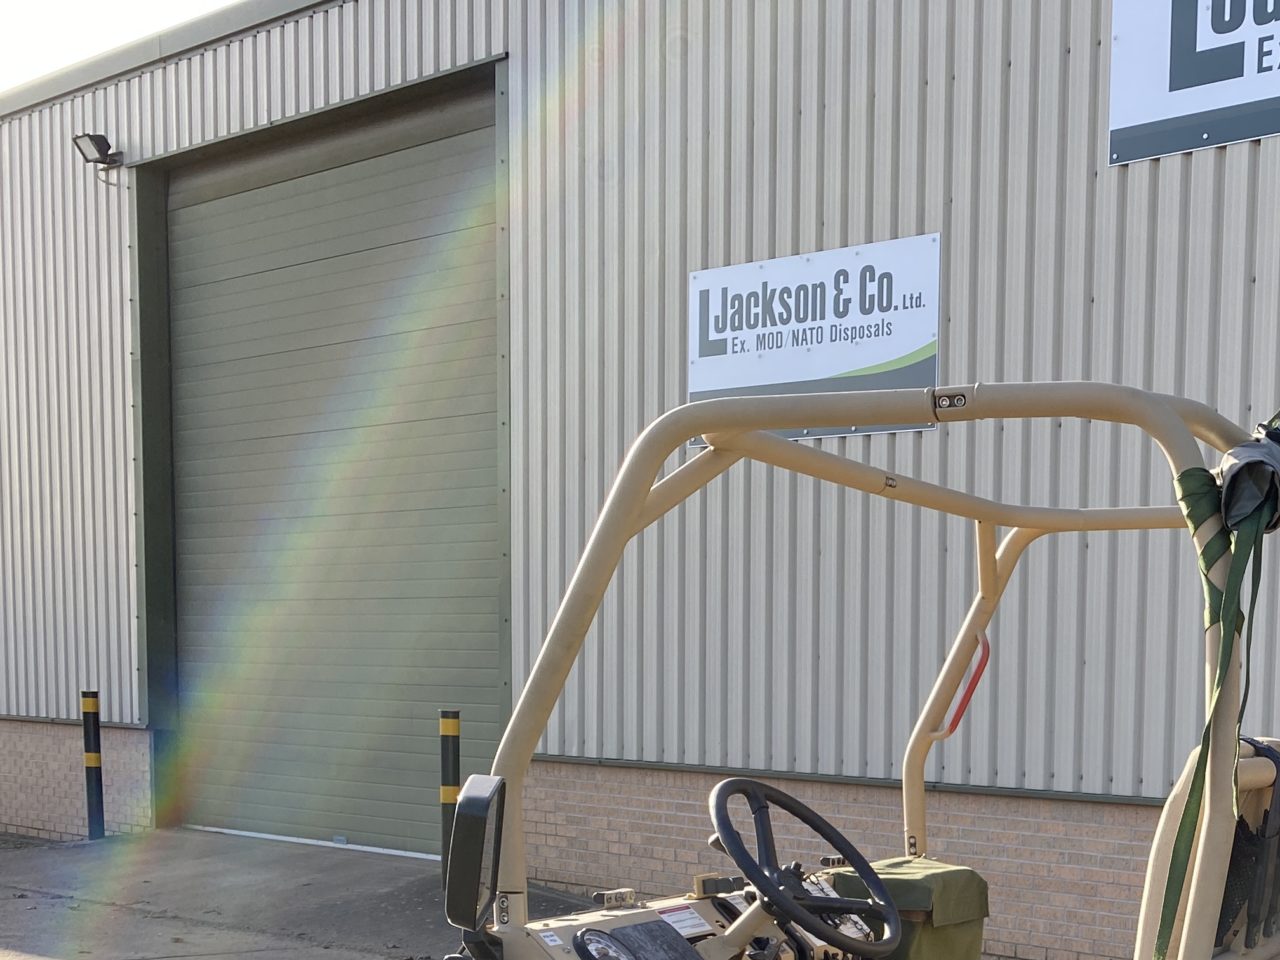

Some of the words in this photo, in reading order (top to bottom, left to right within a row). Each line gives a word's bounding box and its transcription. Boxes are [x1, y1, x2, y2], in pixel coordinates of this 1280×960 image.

[833, 268, 852, 319] &
[859, 264, 899, 316] Co.
[902, 292, 926, 311] Ltd.
[731, 336, 751, 354] Ex.
[756, 326, 824, 352] MOD/NATO
[830, 318, 893, 345] Disposals
